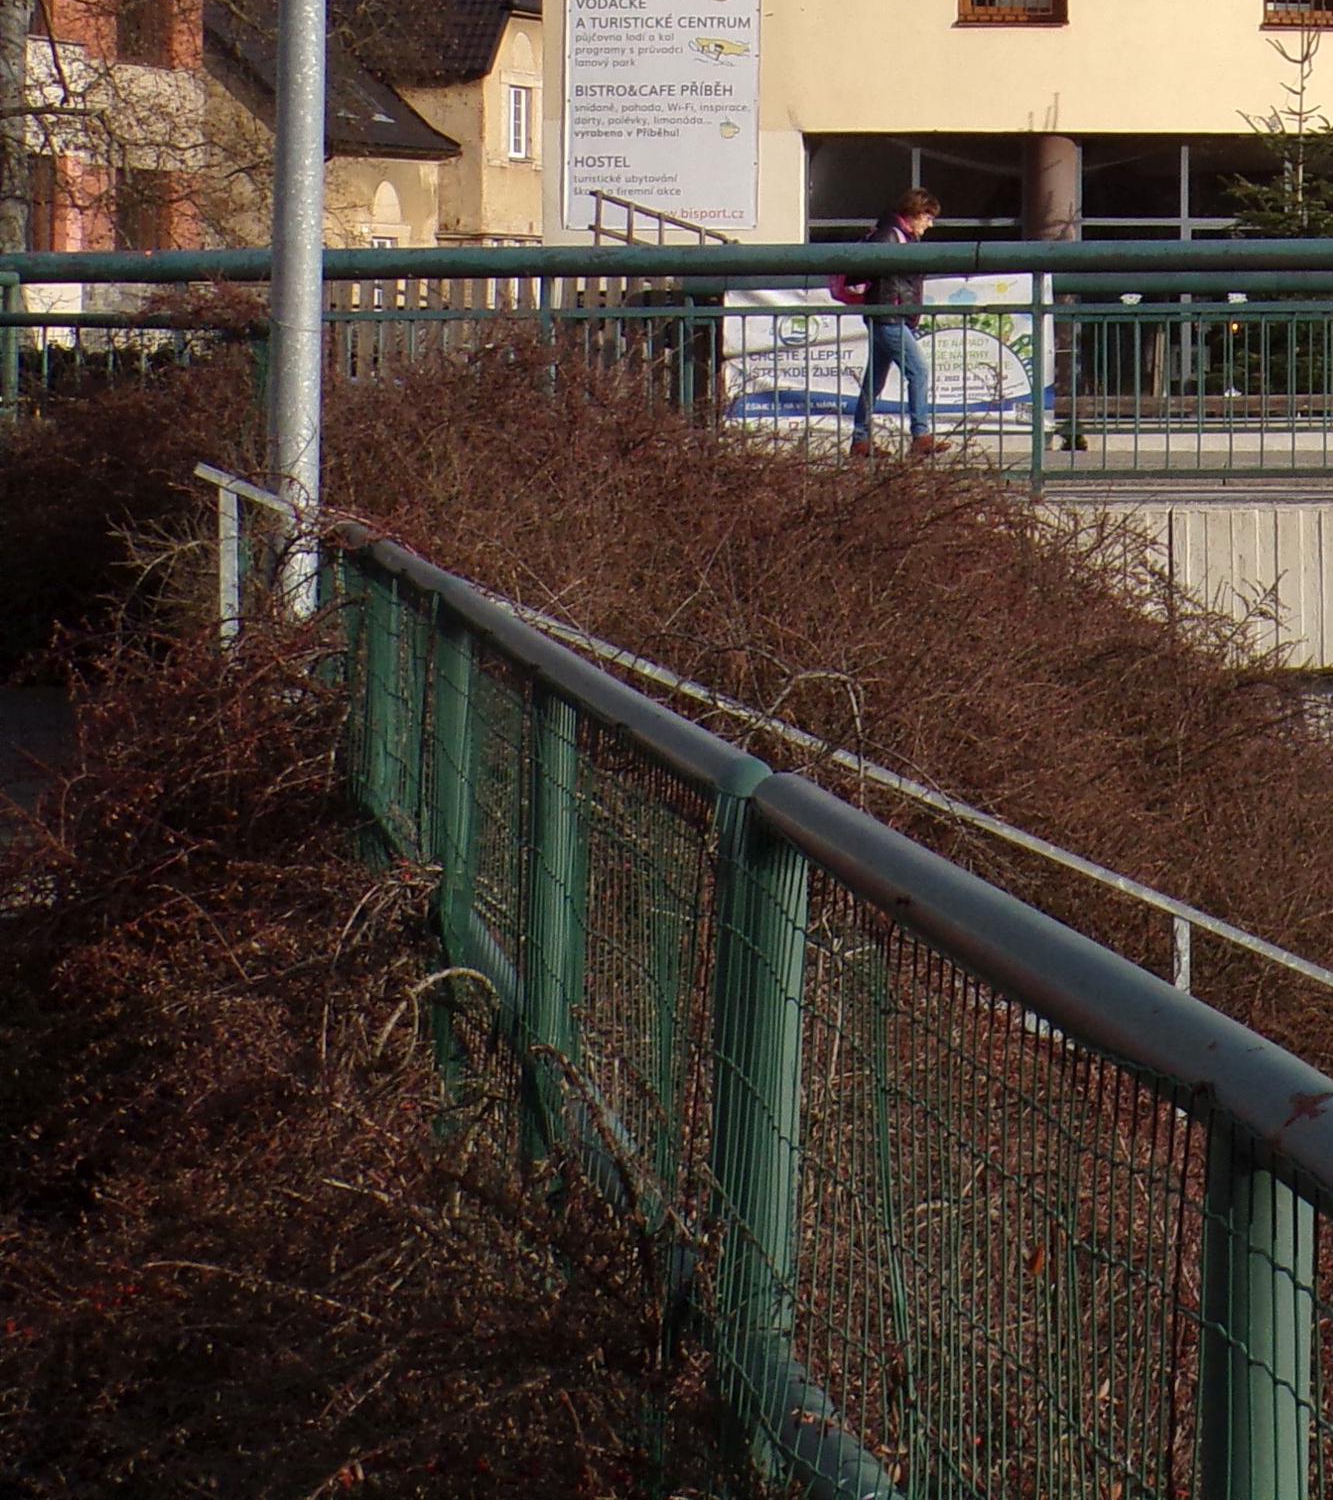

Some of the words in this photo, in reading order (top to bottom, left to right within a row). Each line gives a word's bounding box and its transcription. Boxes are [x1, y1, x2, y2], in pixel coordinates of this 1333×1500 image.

[575, 17, 586, 29] A
[590, 13, 673, 29] TURISTICKÉ
[677, 16, 751, 29] CENTRUM
[575, 32, 623, 43] půjčovna
[658, 32, 674, 42] kol
[575, 46, 626, 56] programy
[629, 46, 635, 54] s
[638, 44, 684, 56] průvodci
[575, 57, 609, 68] lanový
[612, 58, 636, 68] park
[575, 84, 676, 97] BISTRO&CAFE
[680, 81, 733, 97] PŘÍBĚH
[574, 155, 631, 168] HOSTEL
[574, 173, 621, 183] turistické
[625, 173, 678, 185] ubytování
[616, 187, 653, 196] firemní
[656, 187, 682, 196] akce
